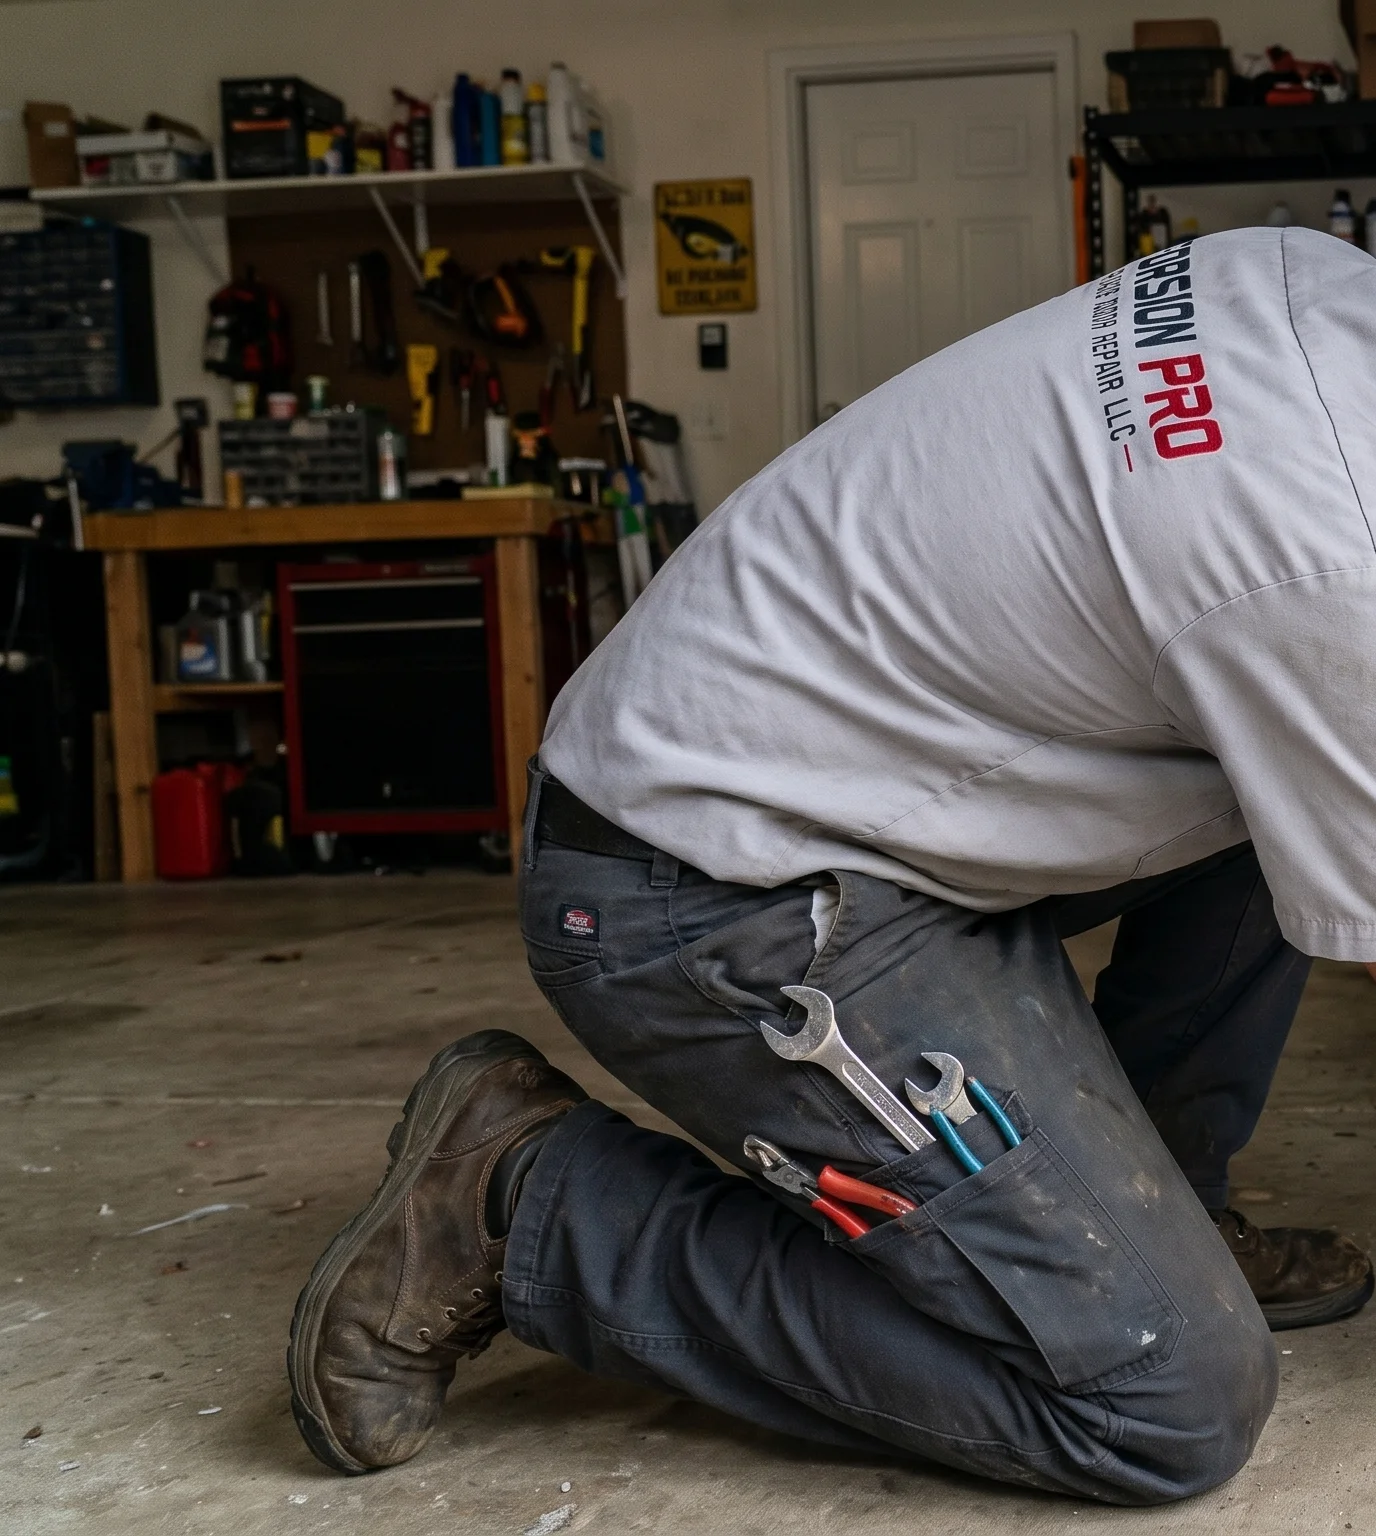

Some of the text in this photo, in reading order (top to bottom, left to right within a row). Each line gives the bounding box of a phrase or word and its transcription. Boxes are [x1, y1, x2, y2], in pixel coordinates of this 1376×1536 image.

[1092, 331, 1124, 394] REPAIR
[1103, 397, 1136, 442] LLC
[1137, 353, 1224, 460] PRO
